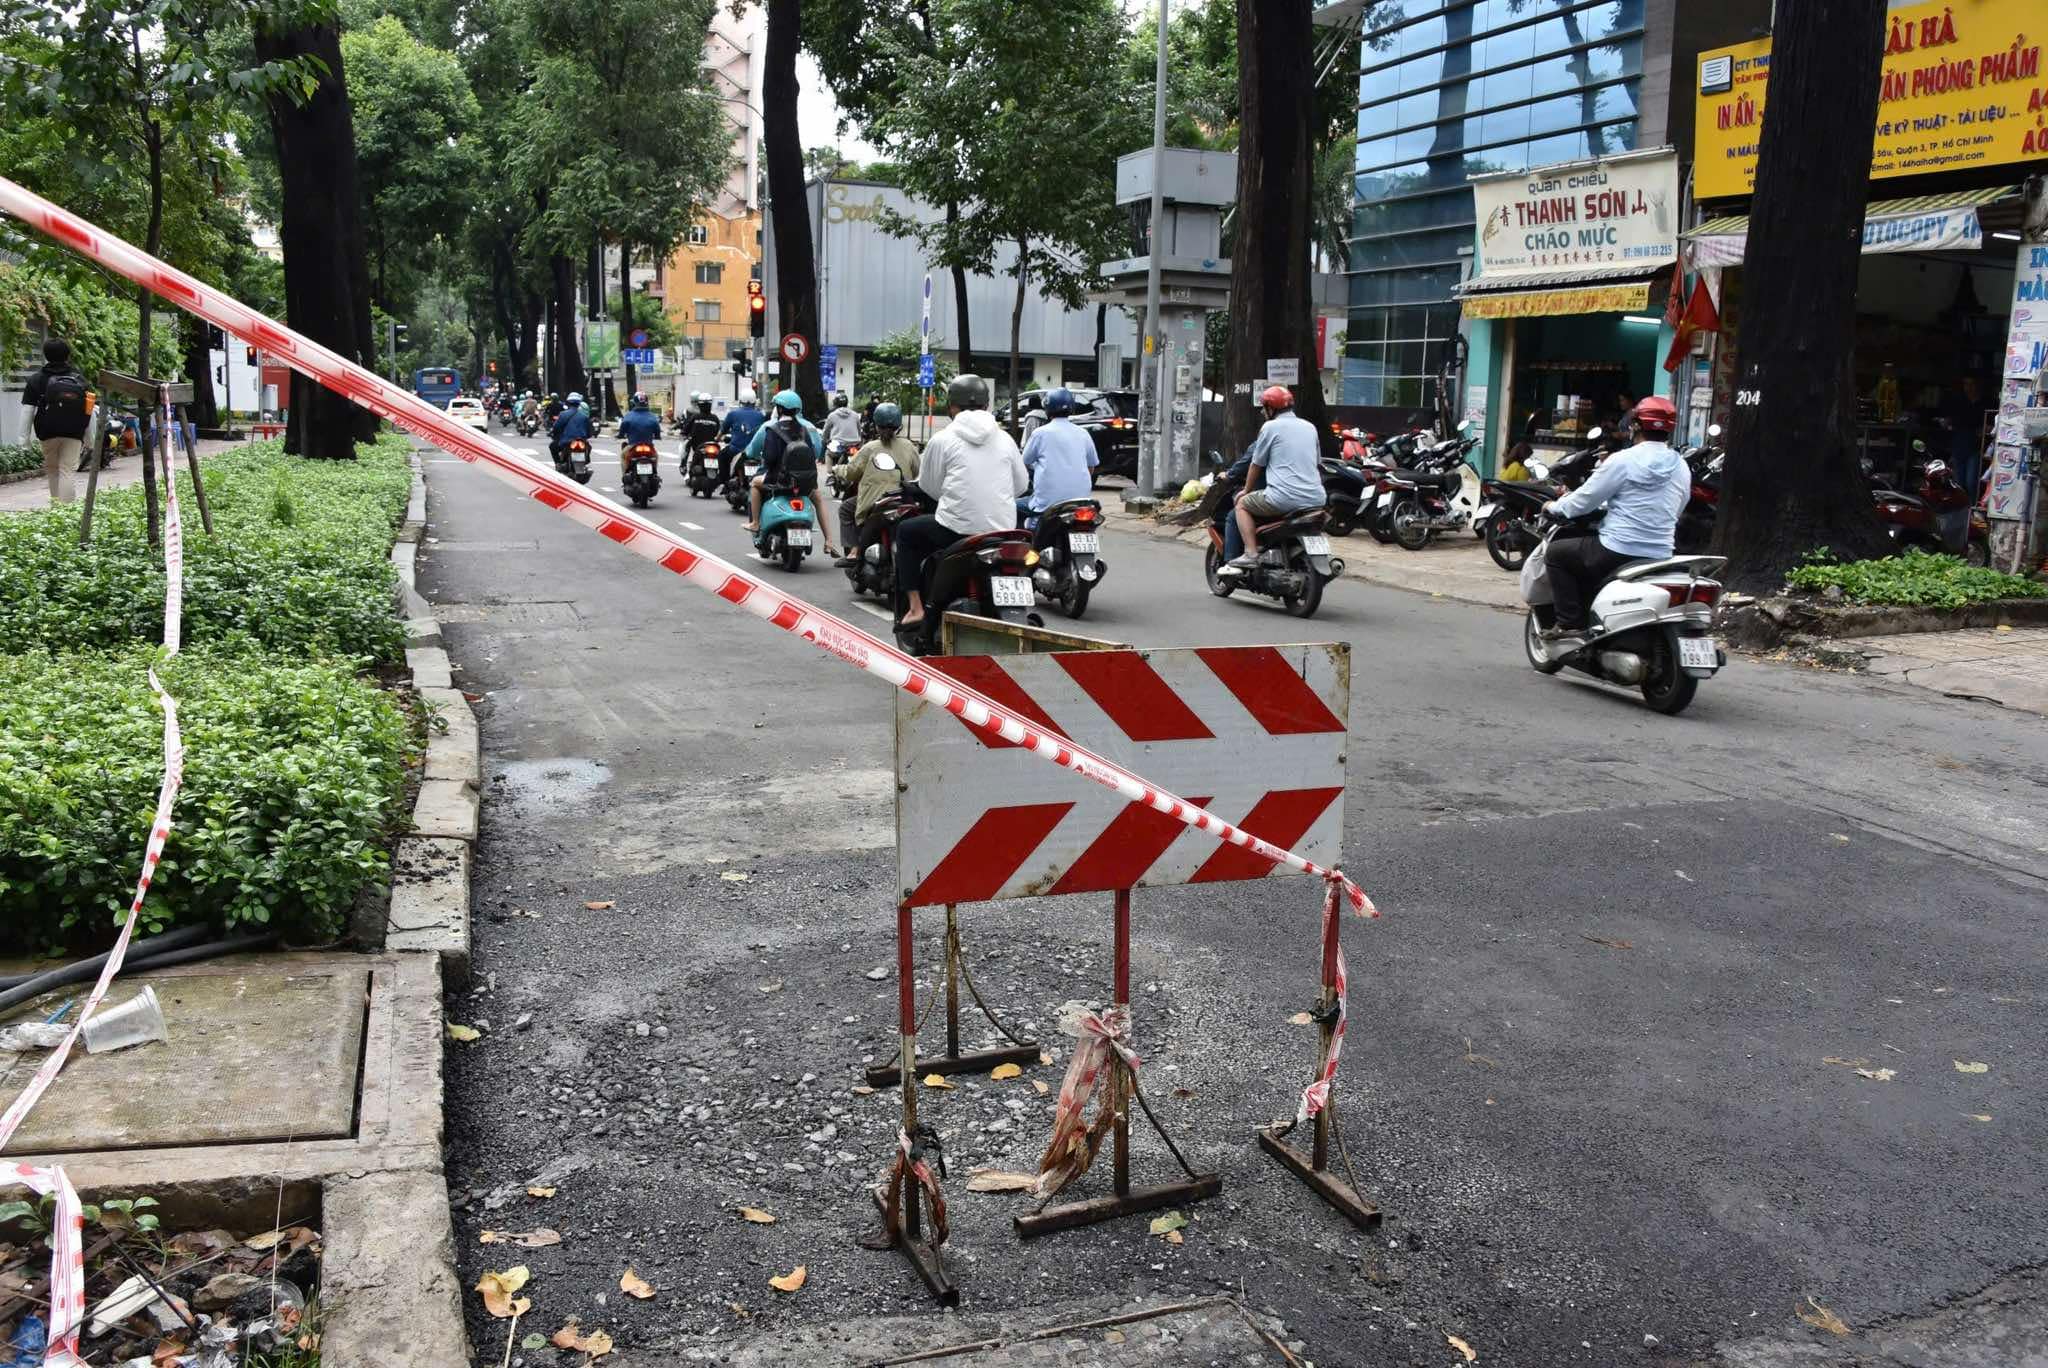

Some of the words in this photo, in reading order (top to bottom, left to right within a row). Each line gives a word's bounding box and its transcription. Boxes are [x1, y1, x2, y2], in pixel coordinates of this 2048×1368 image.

[1883, 16, 1914, 56] ẢI
[1920, 7, 1958, 48] HÀ
[1881, 69, 1907, 103] ĂN
[1912, 57, 1975, 98] PHÒNG
[1979, 33, 2040, 87] PHẨM
[1718, 104, 1731, 130] IN
[1735, 91, 1754, 127] ẤN
[1913, 113, 1947, 131] THUẬT
[1958, 108, 1975, 125] TÀI
[1979, 104, 2006, 123] LIỆU
[1727, 147, 1736, 160] IN
[1895, 144, 1918, 155] Quận
[1973, 134, 1994, 145] Minh
[1898, 152, 1985, 169] 144haiha@gmail.com
[1515, 196, 1577, 226] THANH
[1584, 188, 1626, 220] SƠN
[1525, 228, 1570, 251] CHÁO
[1578, 223, 1617, 249] MỰC
[1863, 215, 1949, 245] OTOCOPY
[2017, 274, 2048, 302] MÀ
[1736, 390, 1761, 406] 204
